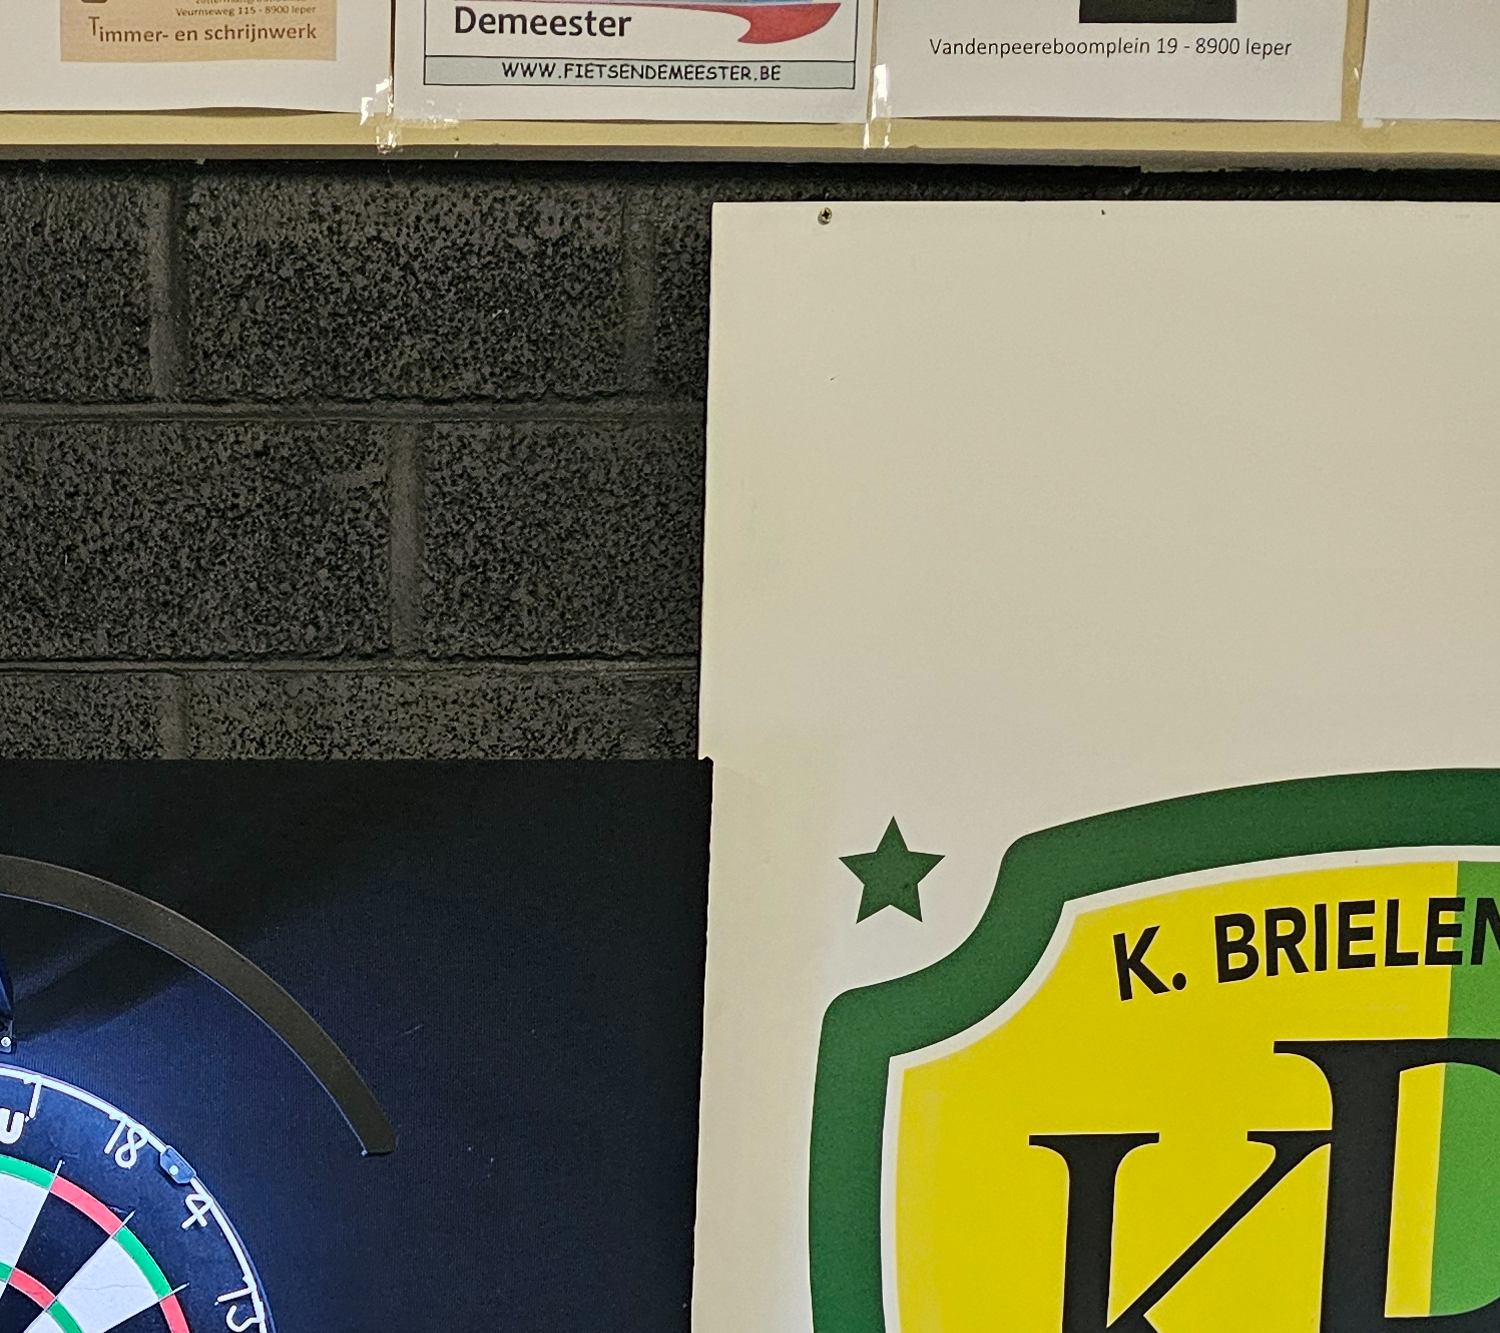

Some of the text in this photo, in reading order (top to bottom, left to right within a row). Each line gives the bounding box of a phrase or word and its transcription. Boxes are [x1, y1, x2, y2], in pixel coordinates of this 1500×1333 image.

[265, 5, 289, 14] 8900
[454, 6, 631, 37] Demeester
[88, 16, 317, 43] Timmer- en schrijnwerk
[929, 37, 1150, 58] Vandenpeereboomplein
[1157, 38, 1177, 54] 19
[1195, 37, 1240, 54] 8900
[1247, 38, 1292, 60] Ieper
[502, 61, 781, 81] WWW.FIETSENDEMEESTER.BE
[1112, 926, 1186, 1001] K.
[104, 1114, 149, 1169] 18
[182, 1194, 213, 1229] 4
[214, 1274, 265, 1332] 13
